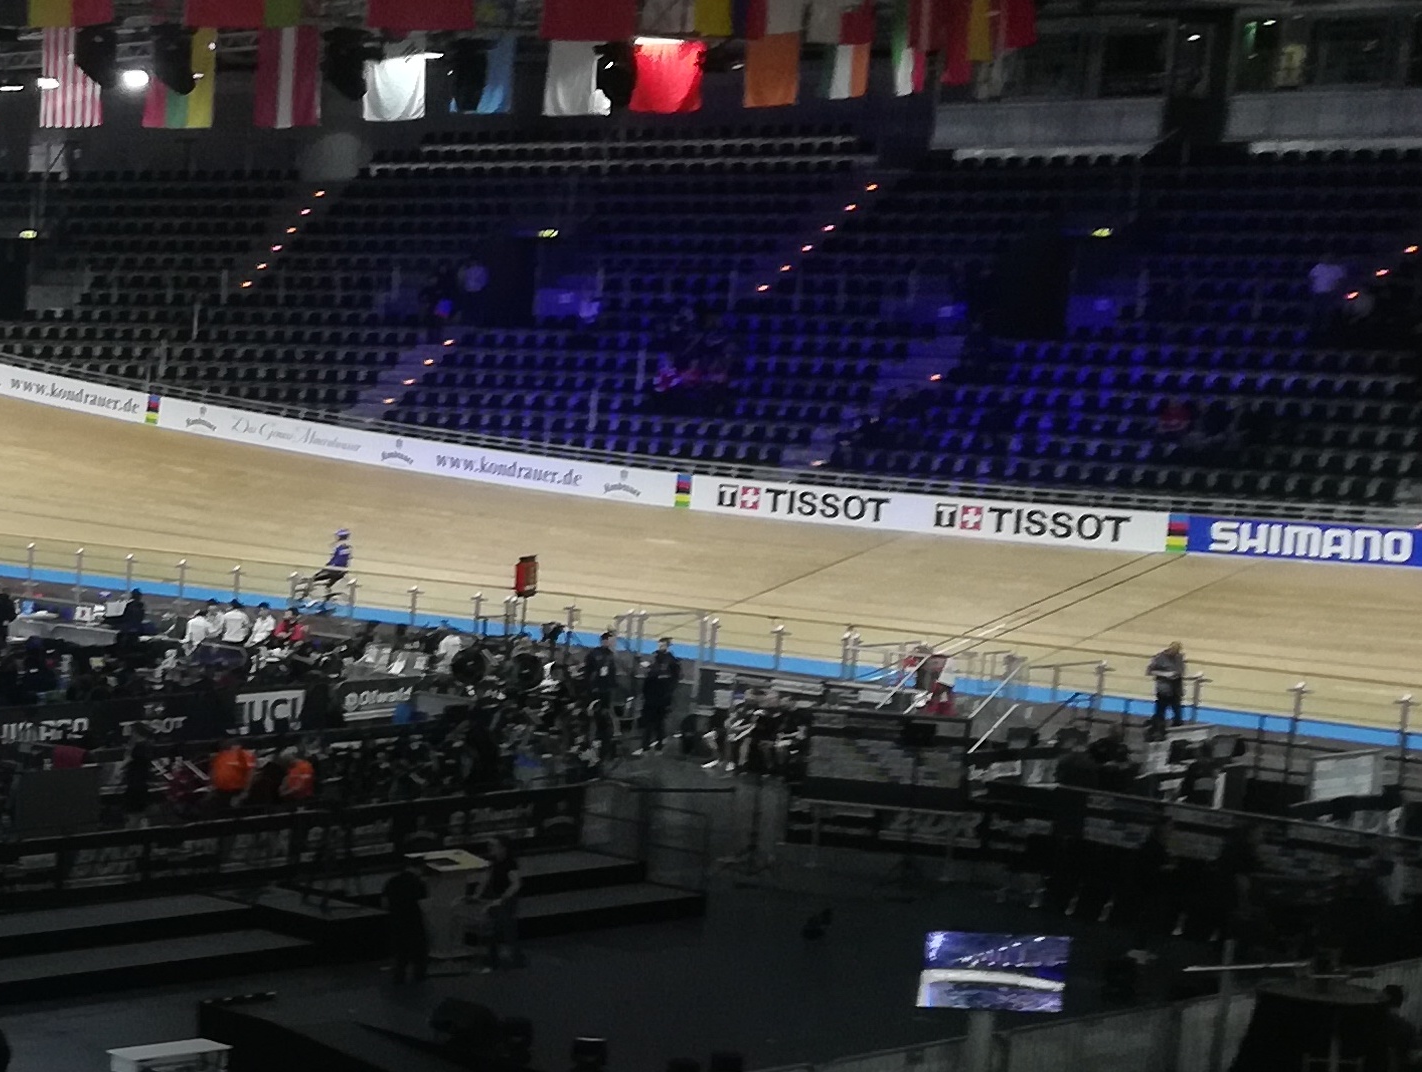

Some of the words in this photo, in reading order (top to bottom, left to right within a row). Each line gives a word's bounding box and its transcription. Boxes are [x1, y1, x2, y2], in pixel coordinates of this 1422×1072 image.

[10, 376, 140, 415] www.kondrauer.de
[436, 452, 582, 488] www.kondrauer.de
[765, 488, 891, 524] TISSOT
[988, 507, 1132, 543] TISSOT
[1209, 519, 1414, 563] SHIMANO
